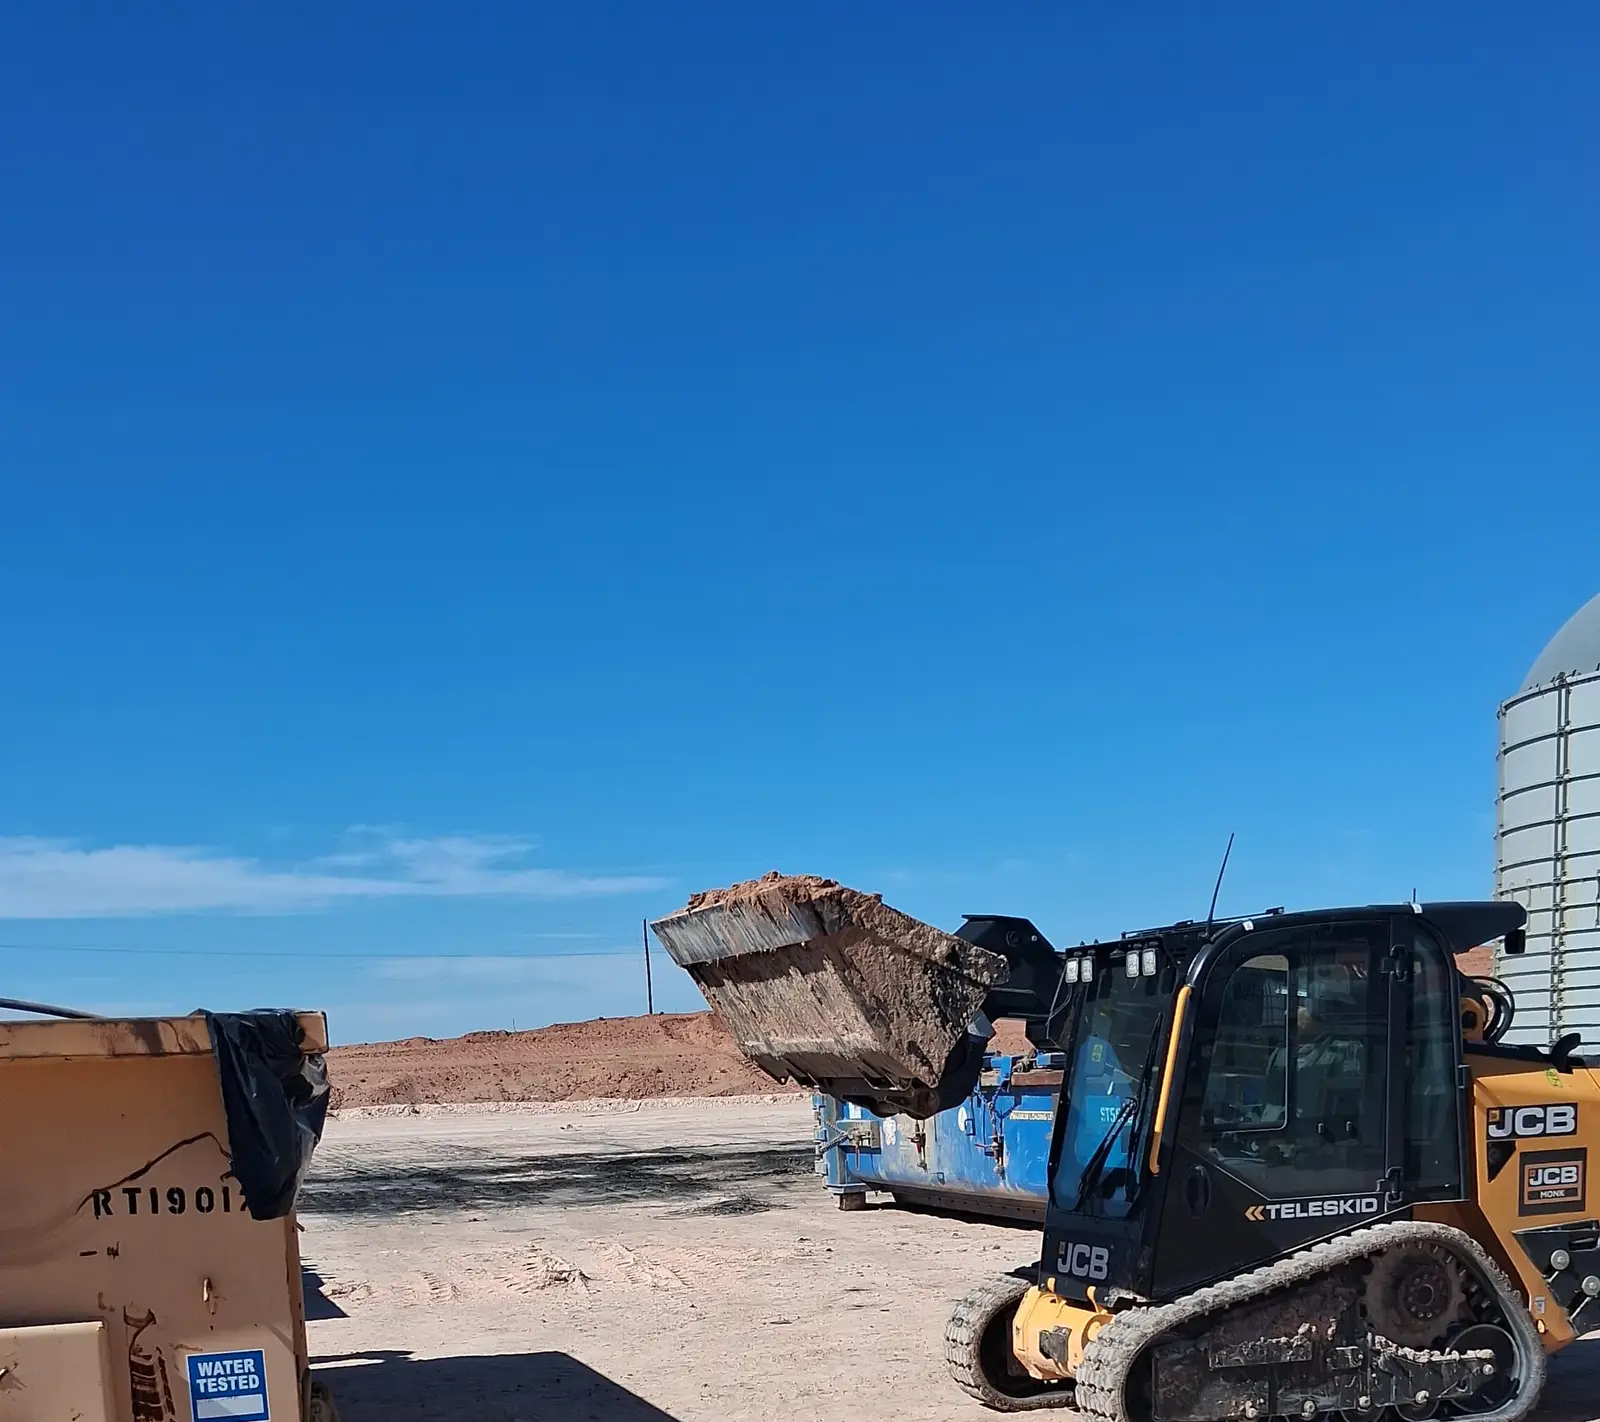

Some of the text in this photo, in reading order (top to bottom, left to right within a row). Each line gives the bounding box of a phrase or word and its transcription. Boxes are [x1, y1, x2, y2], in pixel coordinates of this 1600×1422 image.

[1488, 1105, 1576, 1137] JCB
[1529, 1166, 1578, 1186] JCB
[1540, 1189, 1565, 1199] MONK
[1265, 1197, 1378, 1220] TELESKID
[1057, 1242, 1109, 1280] JCB
[197, 1358, 255, 1377] WATER
[196, 1374, 260, 1393] TESTED
